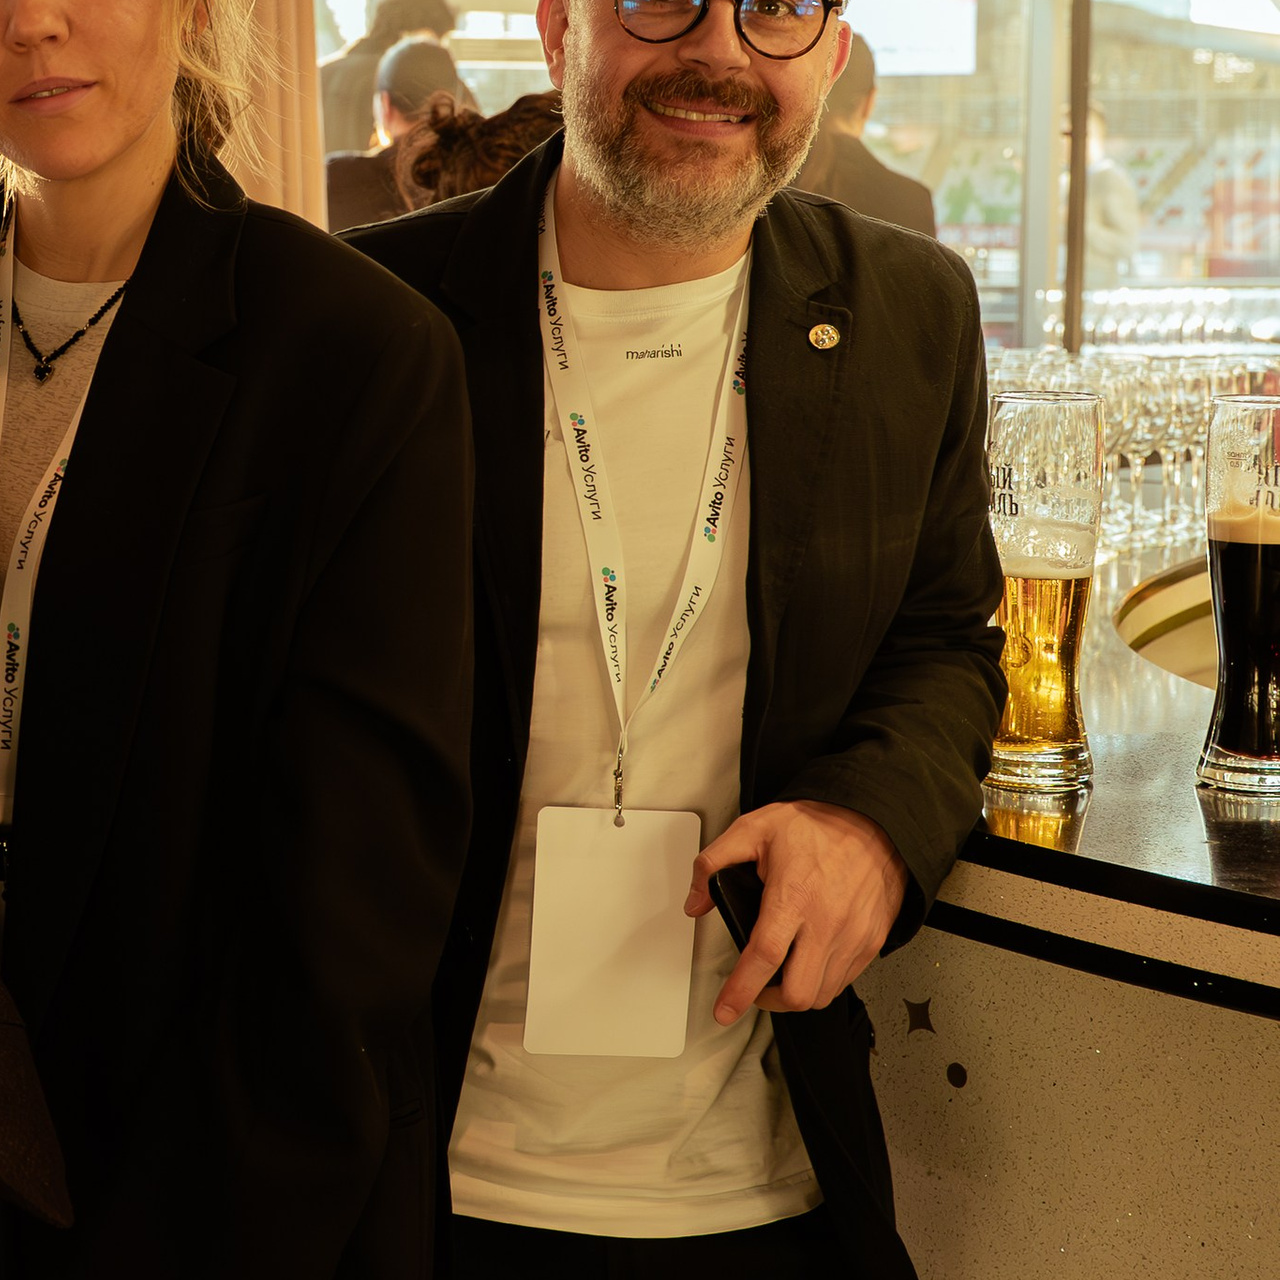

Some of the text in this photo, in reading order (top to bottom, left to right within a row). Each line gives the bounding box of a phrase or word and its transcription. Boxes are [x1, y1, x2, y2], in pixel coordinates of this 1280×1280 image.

[543, 283, 569, 370] Avito Услуги
[626, 344, 682, 360] maharishi
[572, 426, 602, 520] Avito Услуги
[705, 436, 736, 528] Avito Услуги
[16, 472, 64, 570] Avito Услуги
[5, 640, 20, 683] Avito
[603, 583, 623, 684] Avito Услуги
[656, 585, 702, 679] Avito Услуги
